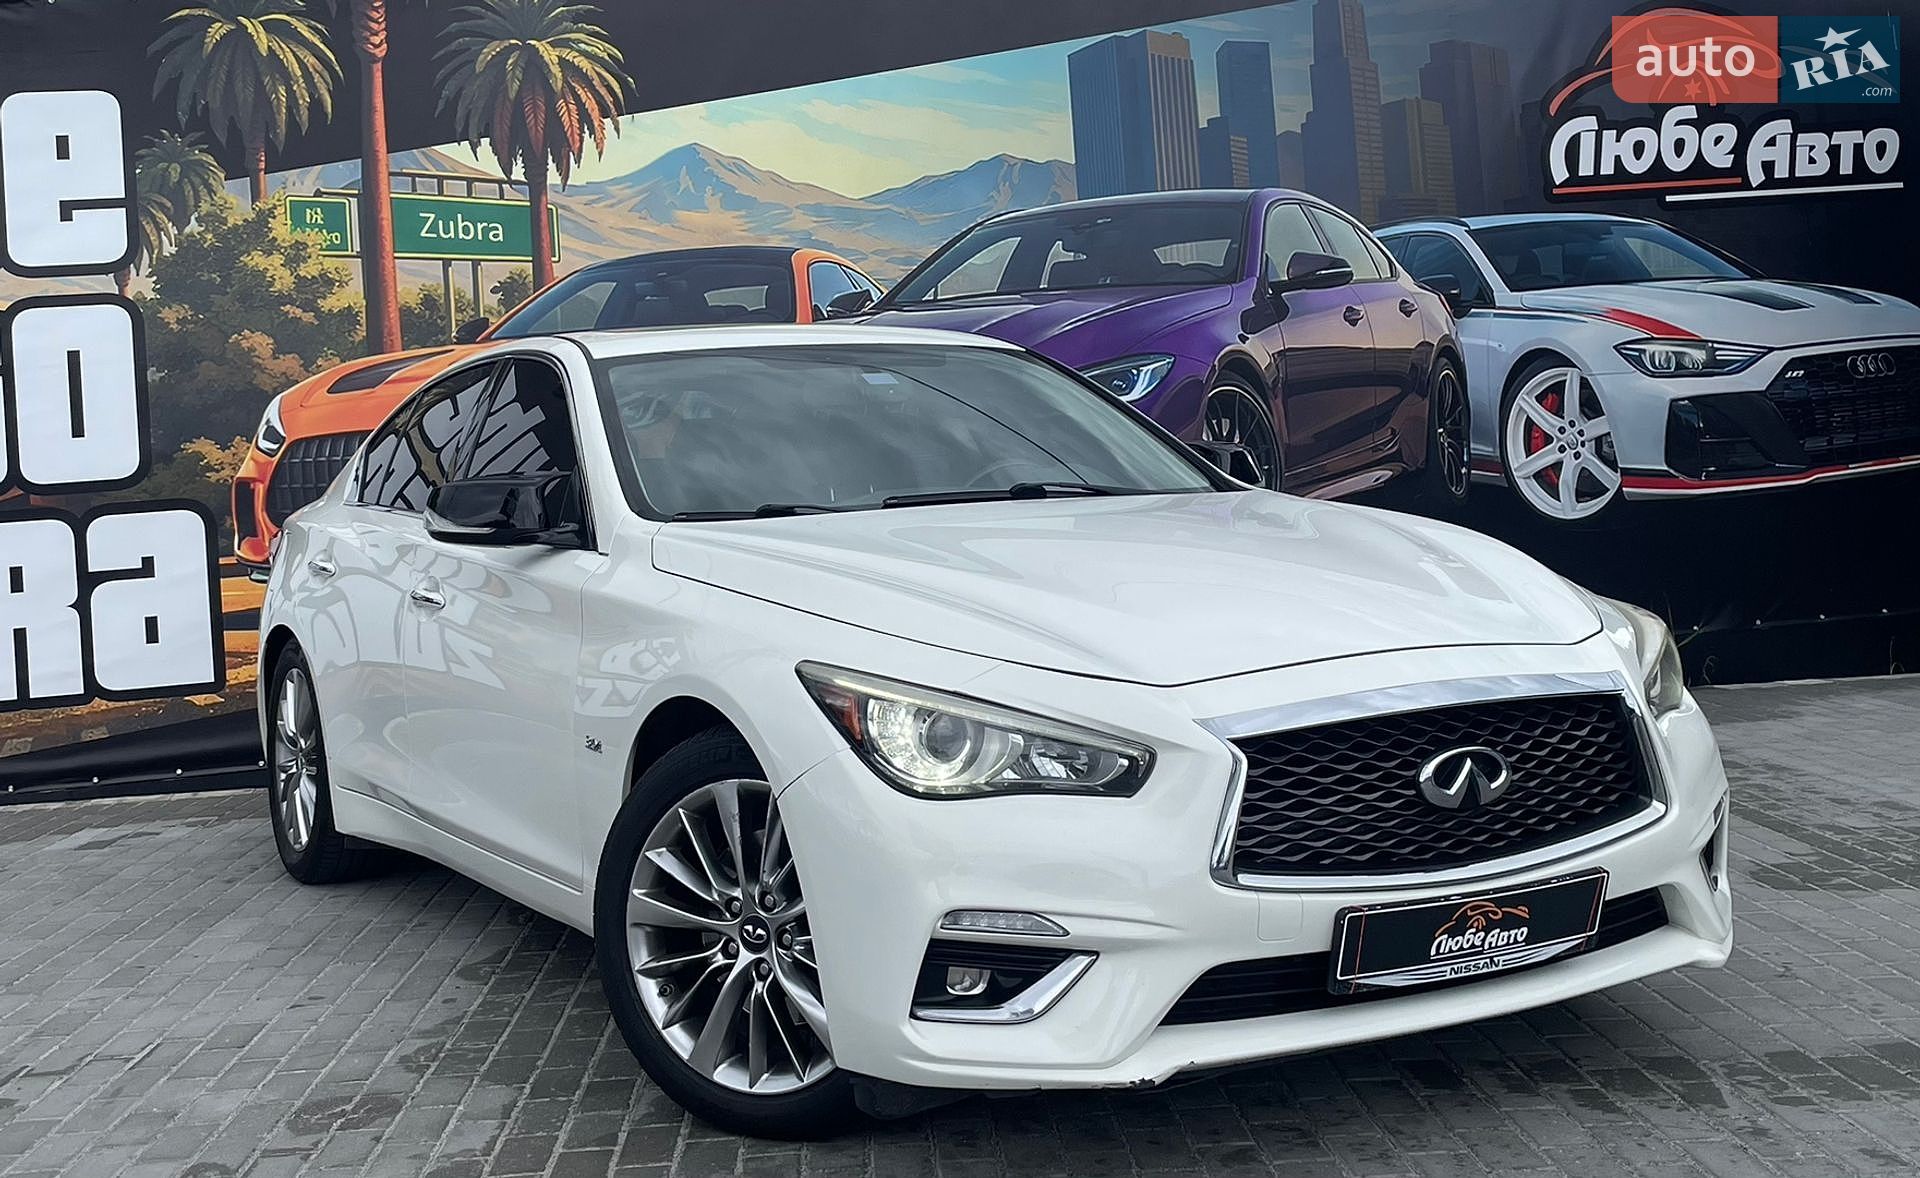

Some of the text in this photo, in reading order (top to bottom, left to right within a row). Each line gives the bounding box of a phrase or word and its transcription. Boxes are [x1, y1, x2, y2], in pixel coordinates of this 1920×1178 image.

[1549, 105, 1900, 188] Любе Авто
[418, 212, 504, 242] Zubra
[1430, 926, 1528, 956] Любе Авто
[1448, 958, 1502, 977] NISSAN
